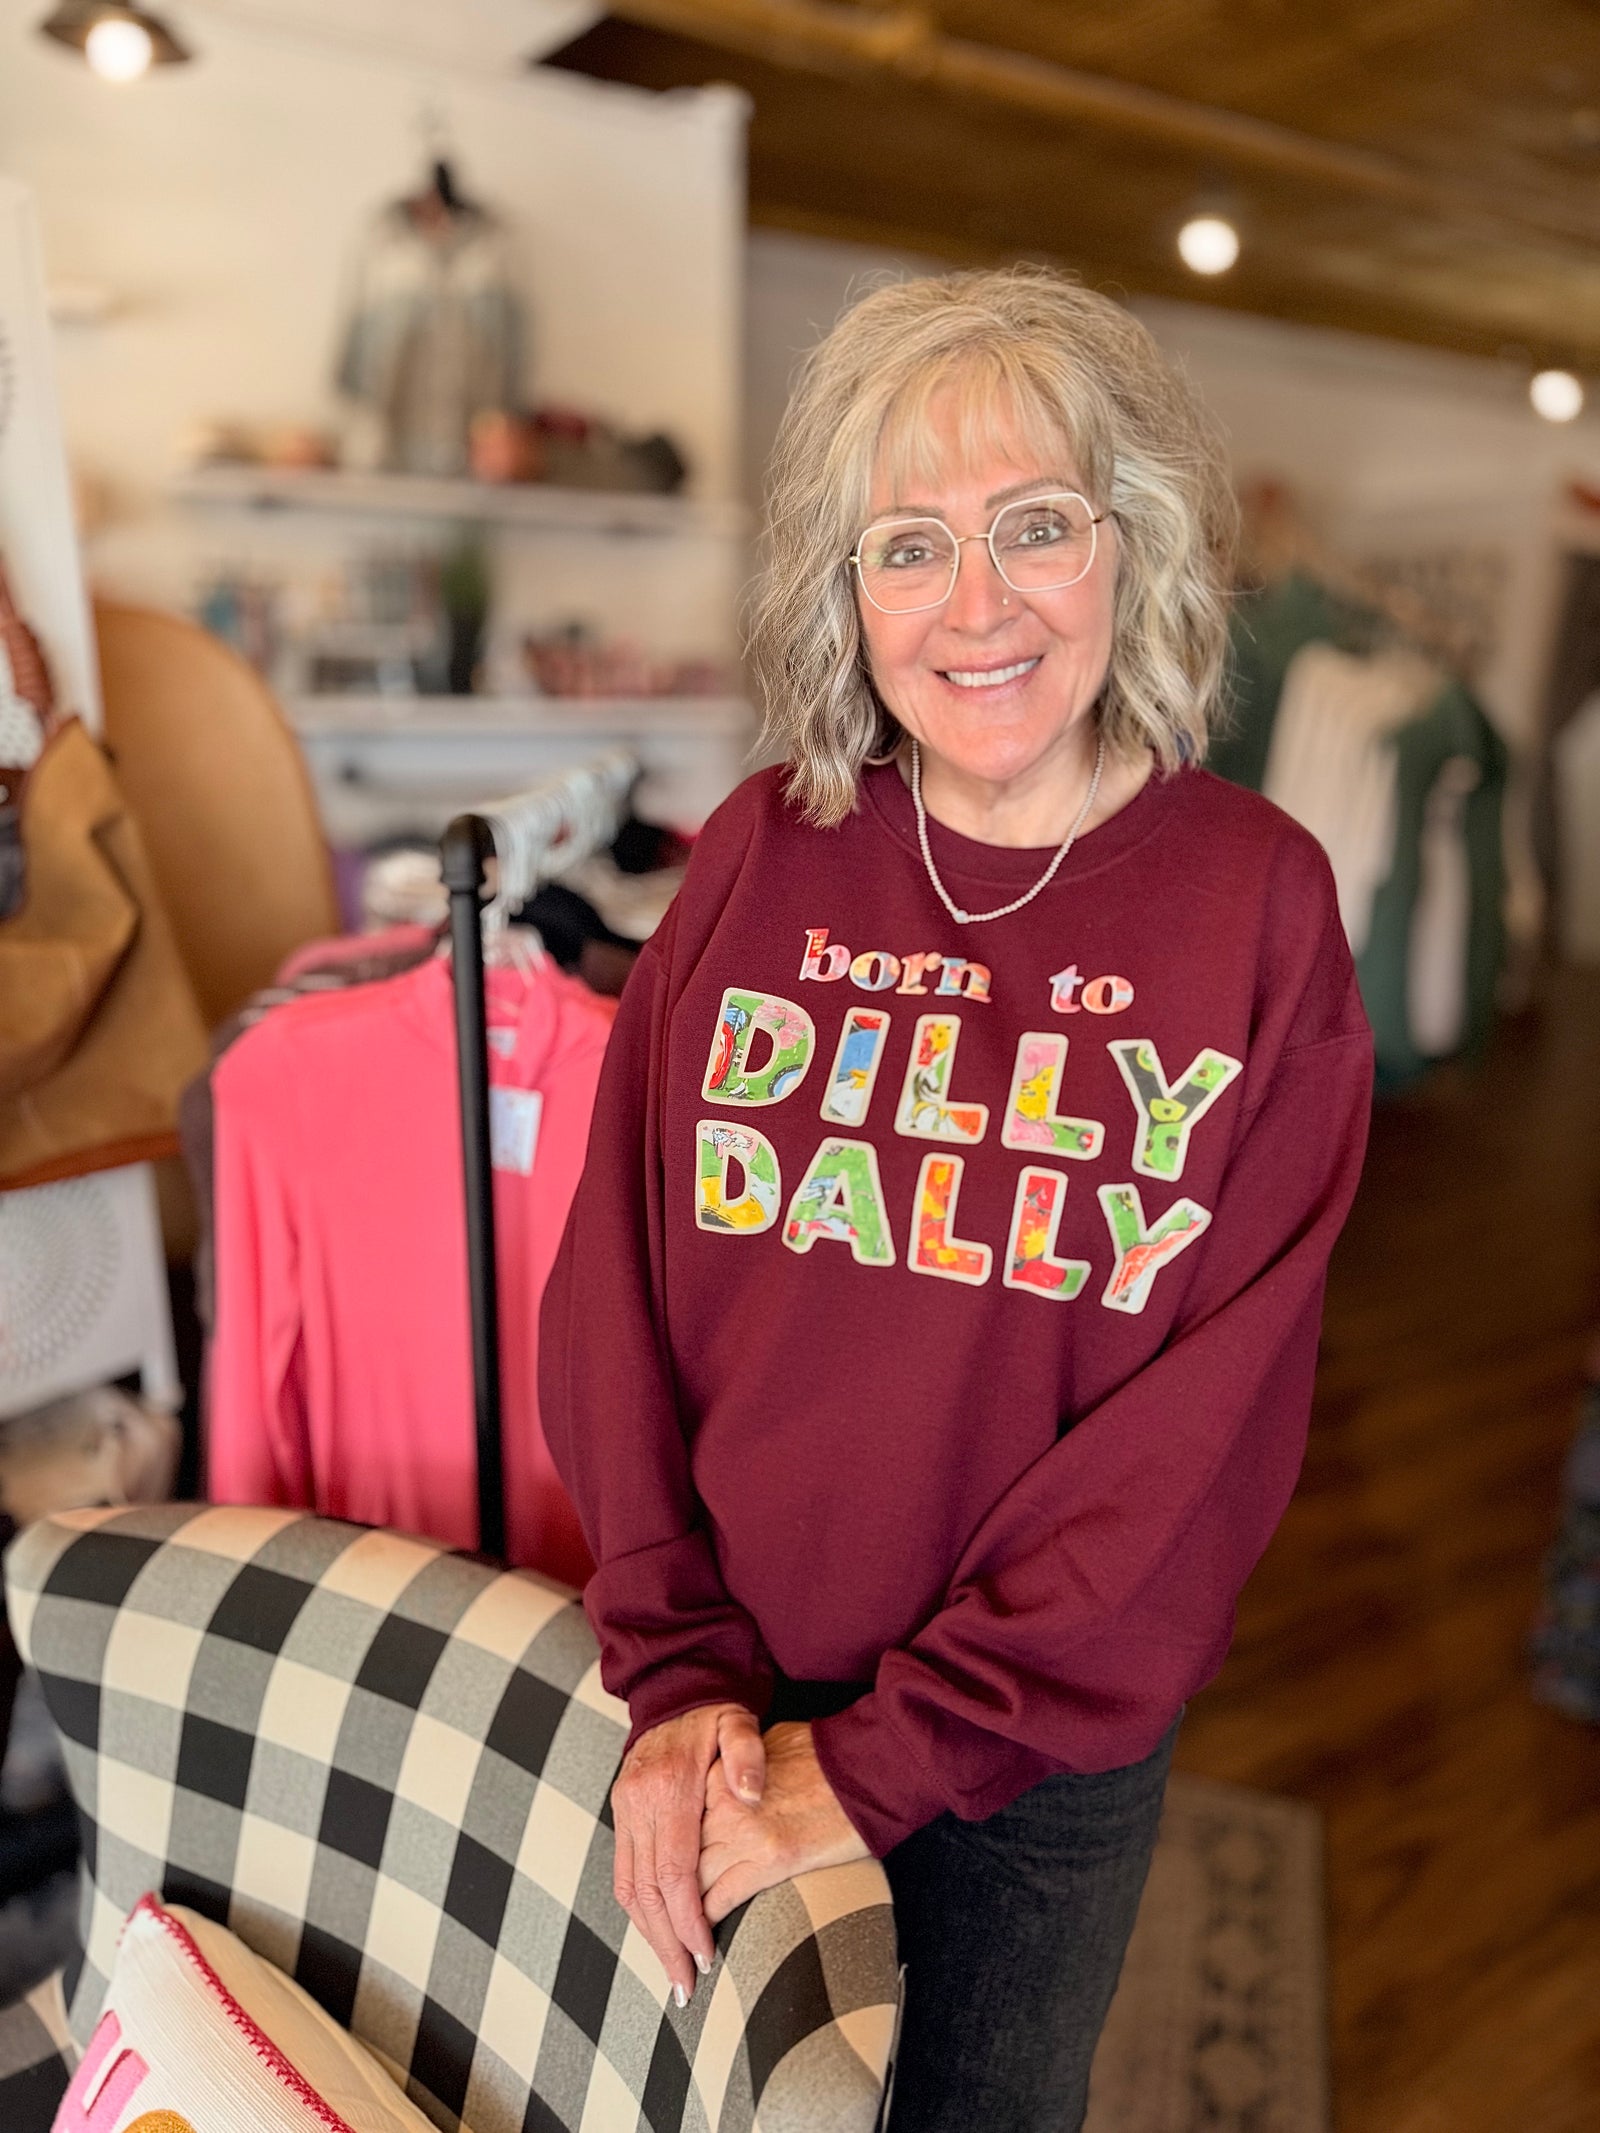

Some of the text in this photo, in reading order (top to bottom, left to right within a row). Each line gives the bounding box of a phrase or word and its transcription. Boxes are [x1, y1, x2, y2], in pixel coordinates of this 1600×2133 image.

[799, 928, 1135, 1014] born to
[701, 987, 1244, 1182] DILLY
[695, 1119, 1213, 1315] DALLY
